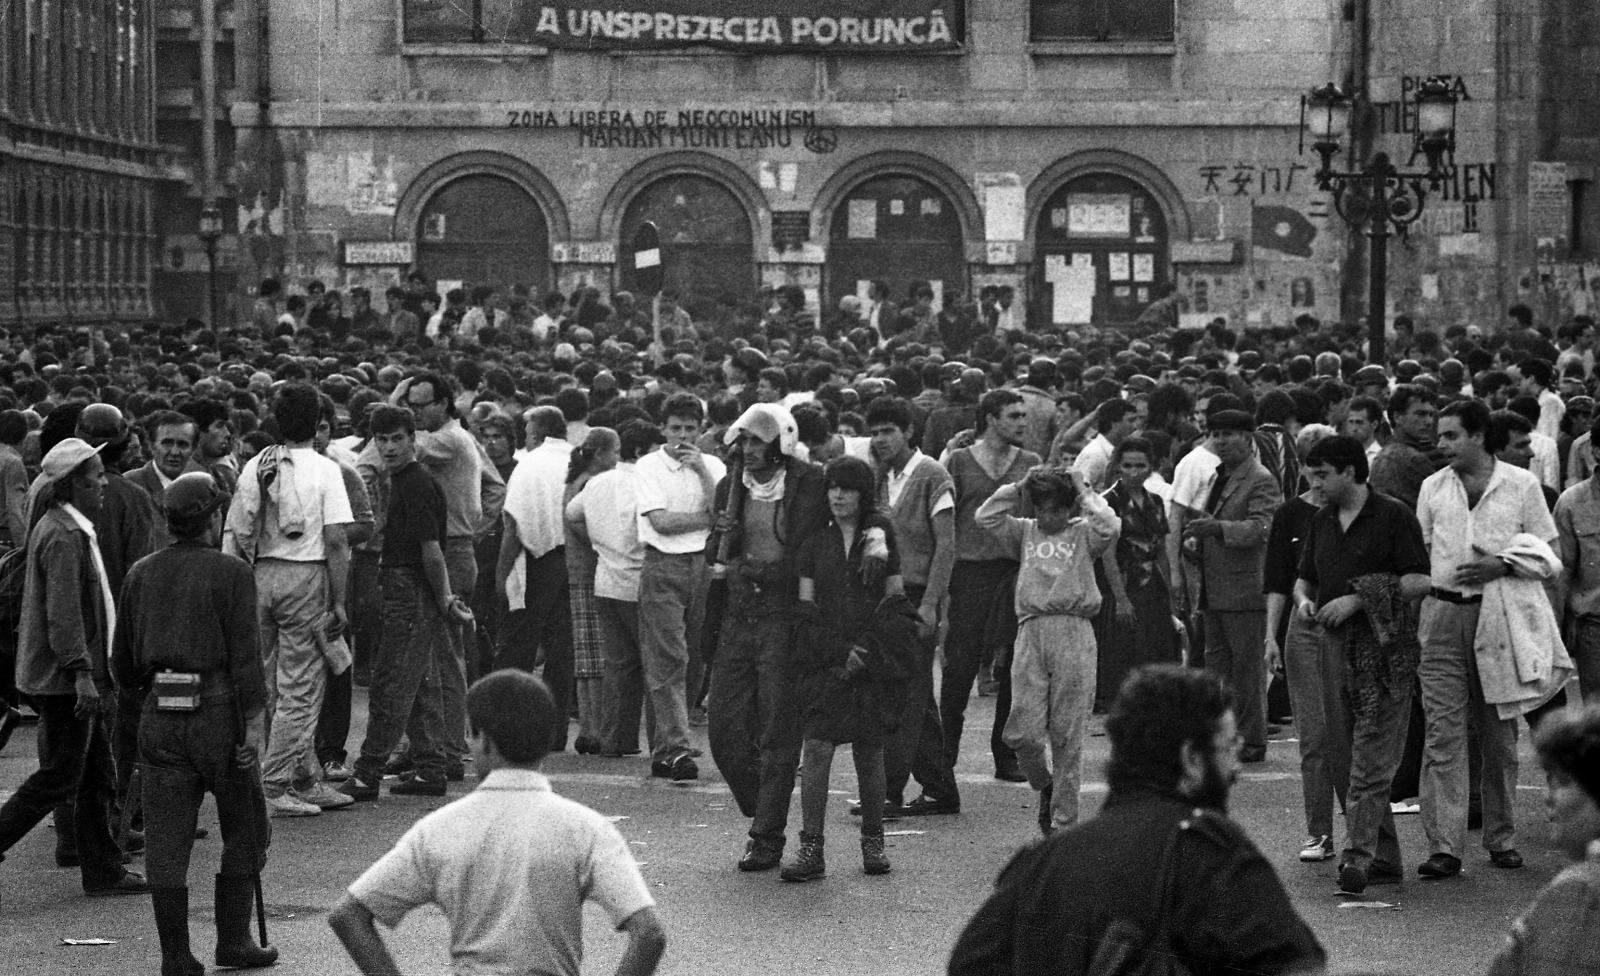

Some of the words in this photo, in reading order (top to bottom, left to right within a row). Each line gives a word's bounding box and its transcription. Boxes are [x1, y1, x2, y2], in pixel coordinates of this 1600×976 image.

[536, 6, 560, 34] A
[567, 8, 783, 44] UNSPREZECEA
[570, 110, 635, 128] LIBERA
[644, 110, 667, 128] DE
[677, 109, 815, 127] NEOCOMUNISM
[579, 125, 663, 148] MARIAN
[669, 125, 791, 149] MUNTEANU
